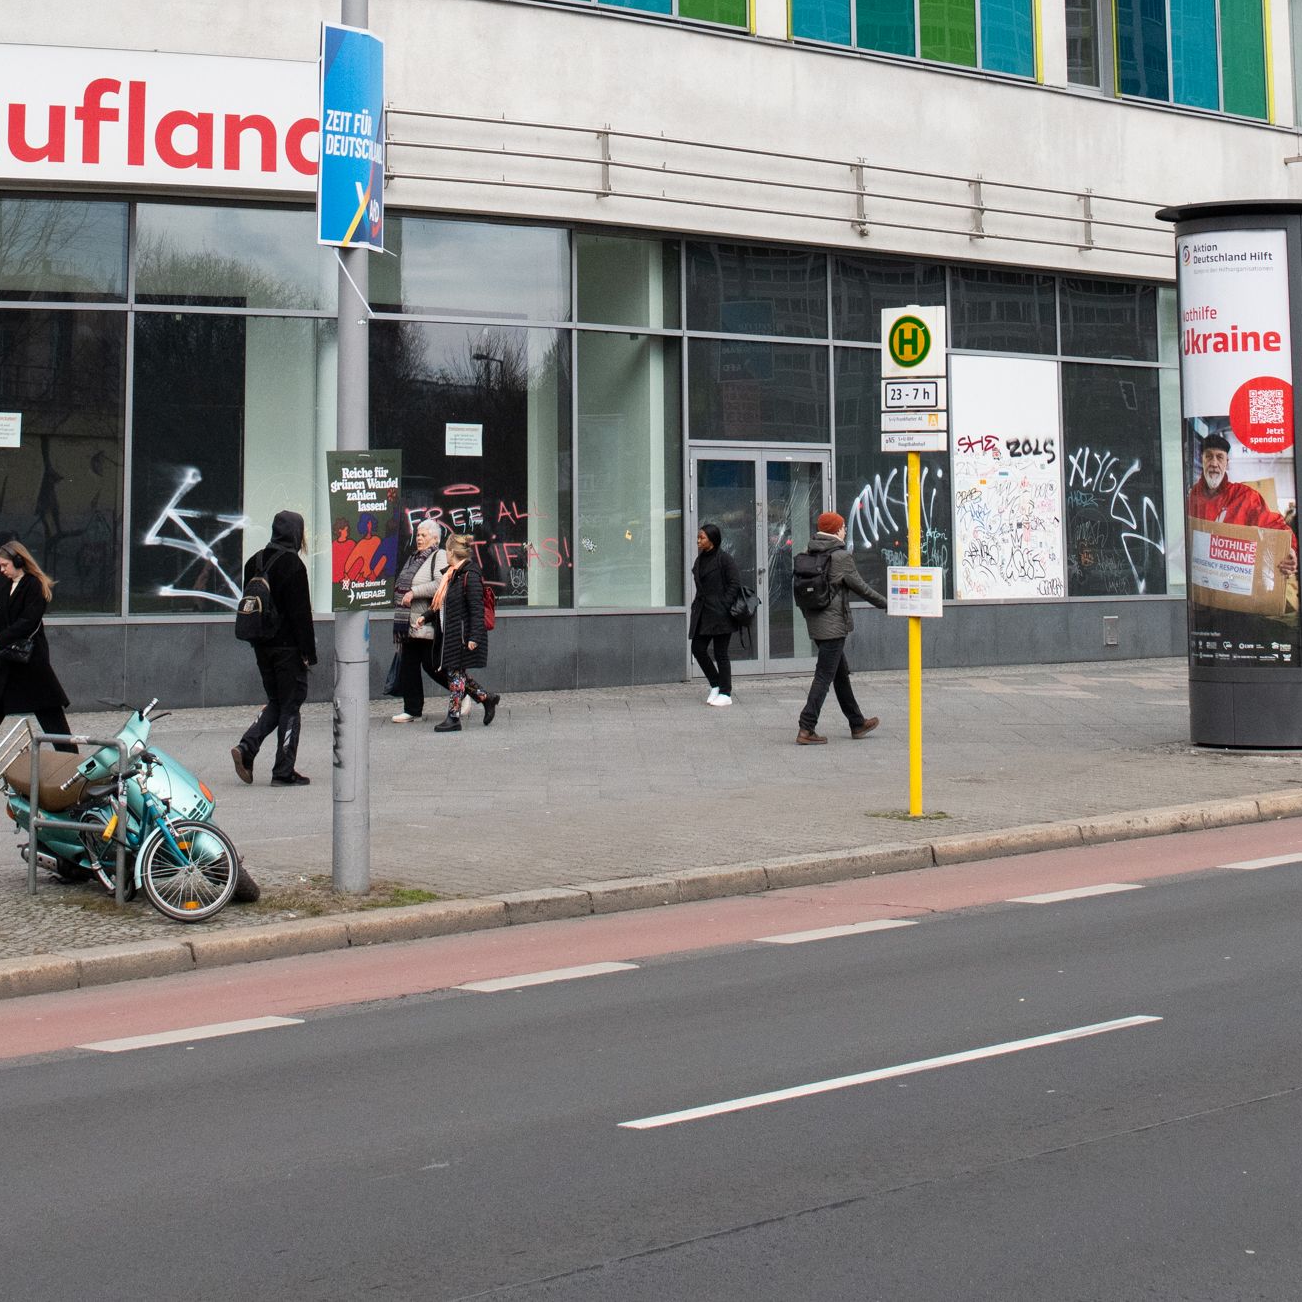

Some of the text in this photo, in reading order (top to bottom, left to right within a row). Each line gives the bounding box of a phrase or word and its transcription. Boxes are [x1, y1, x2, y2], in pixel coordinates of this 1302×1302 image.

[325, 108, 373, 136] ZEIT FÜR
[1193, 243, 1218, 254] Aktion
[1193, 251, 1273, 265] Deutschland Hilft
[898, 327, 918, 356] H
[1183, 324, 1282, 356] Ukraine
[891, 388, 902, 401] 23
[912, 388, 919, 400] 7
[923, 387, 930, 400] h
[1266, 427, 1285, 435] Jetzt
[1249, 436, 1285, 445] spenden!
[341, 466, 389, 479] Reiche für
[330, 477, 399, 493] grünen Wandel
[346, 489, 377, 501] zahlen
[357, 499, 388, 512] lassen!
[1211, 537, 1257, 553] NOTHILFE
[1211, 548, 1255, 564] UKRAINE
[1219, 563, 1253, 575] RESPONSE
[356, 589, 386, 599] MERA25
